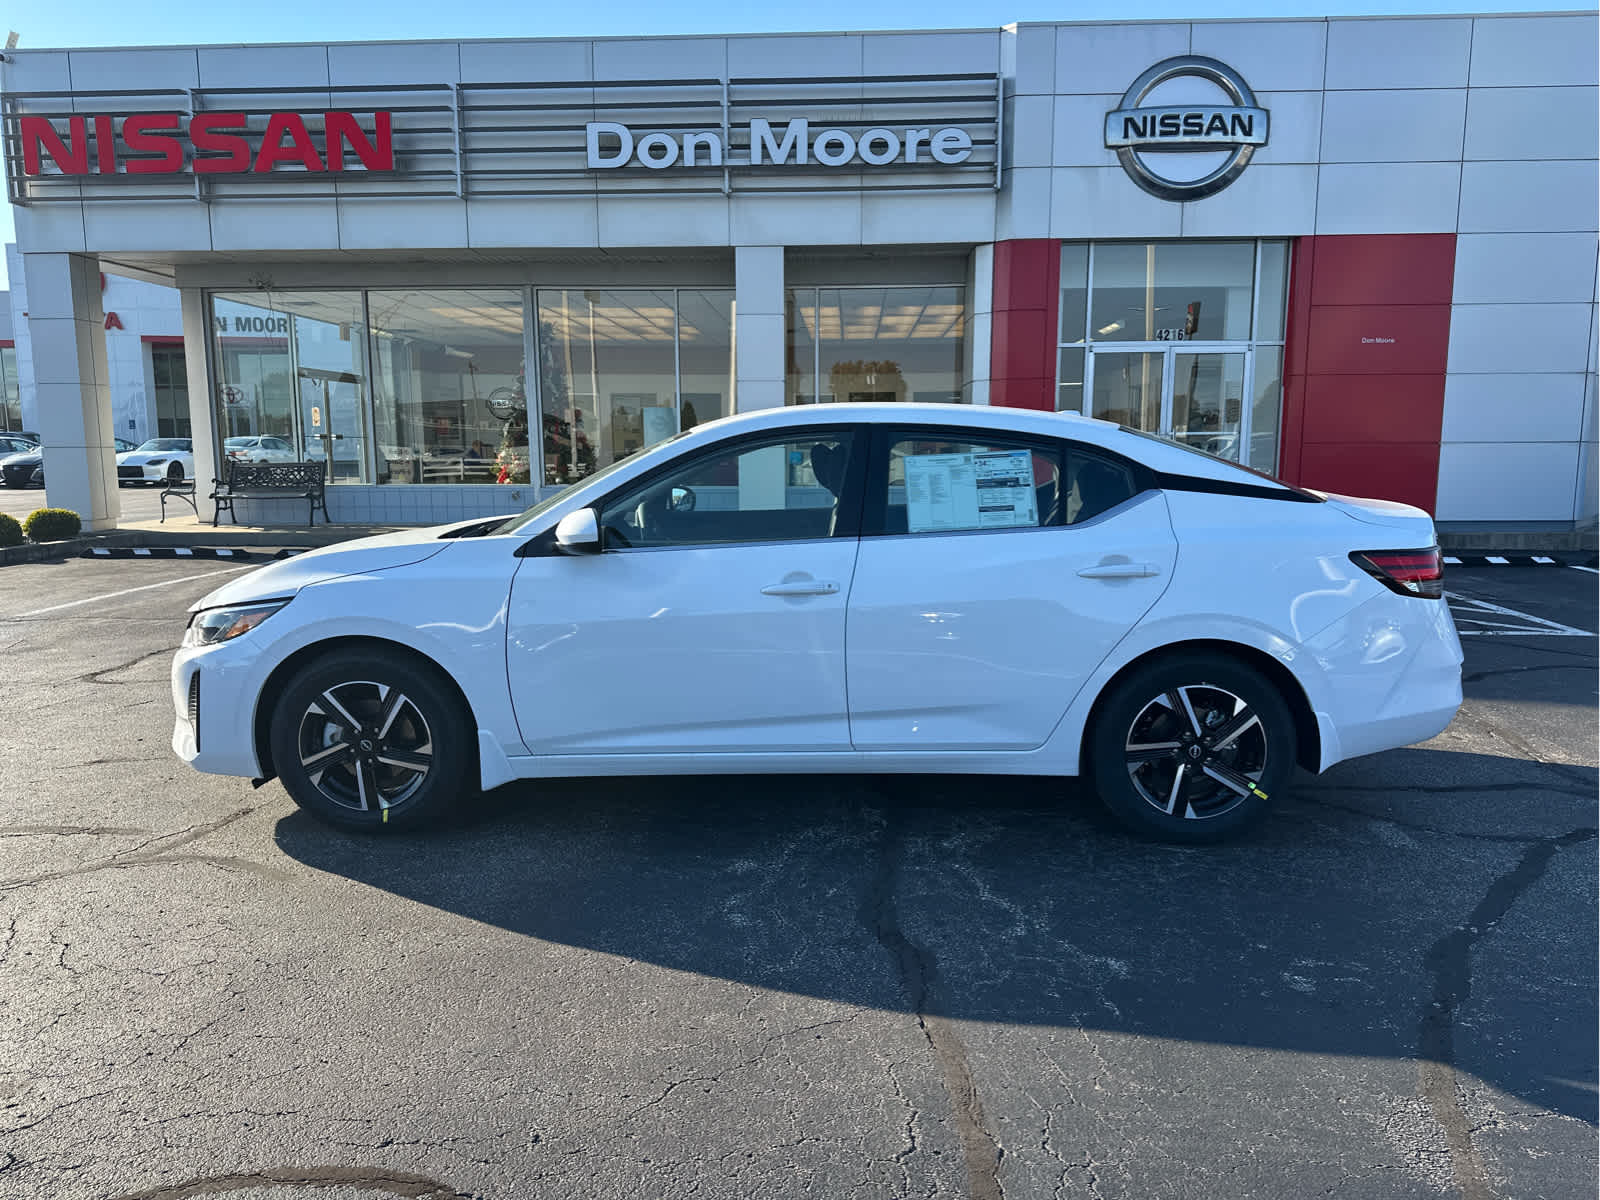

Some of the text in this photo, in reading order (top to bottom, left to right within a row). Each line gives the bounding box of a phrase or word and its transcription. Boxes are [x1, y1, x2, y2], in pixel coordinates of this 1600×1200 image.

[1123, 112, 1253, 139] NISSAN
[20, 111, 394, 175] NISSAN
[586, 117, 972, 169] Don Moore
[235, 316, 298, 333] MOOR
[1156, 329, 1184, 341] 4216
